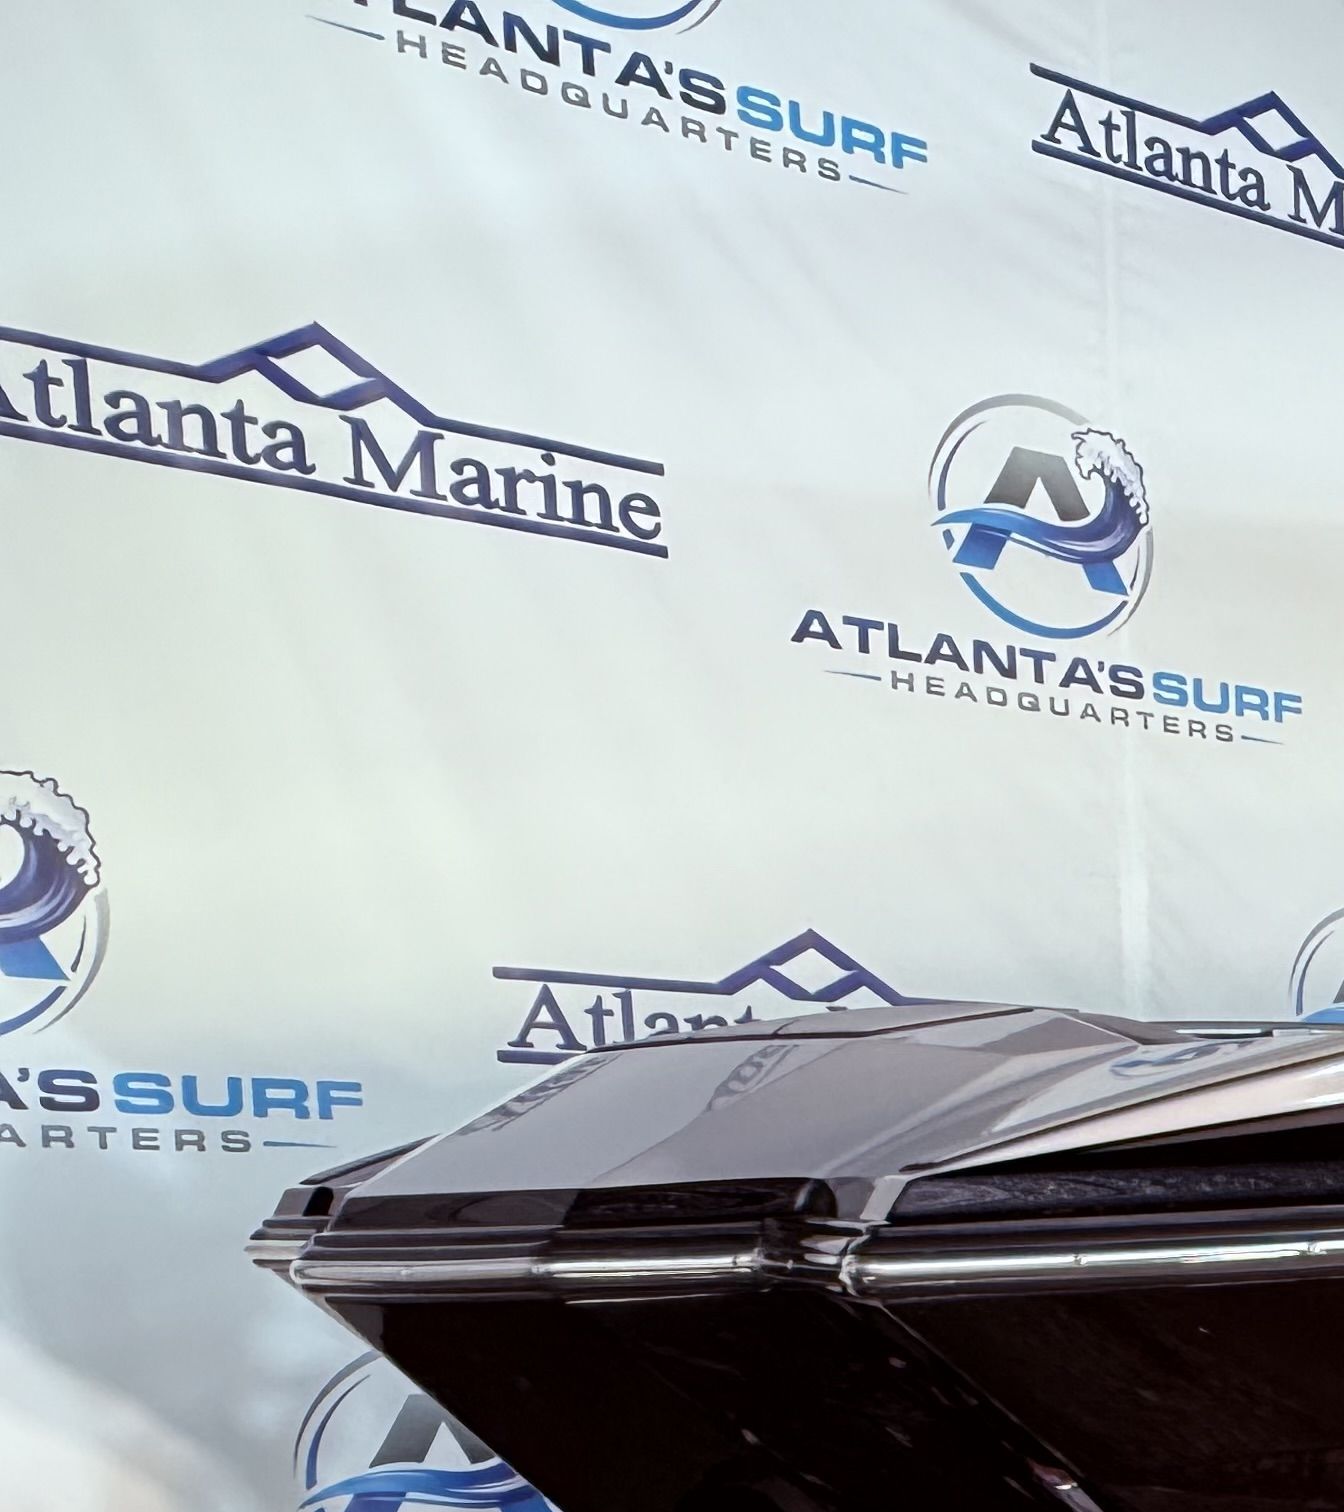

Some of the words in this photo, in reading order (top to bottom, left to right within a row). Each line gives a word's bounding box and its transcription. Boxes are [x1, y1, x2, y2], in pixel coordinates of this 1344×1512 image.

[397, 29, 841, 182] HEADQUARTERS
[1041, 89, 1270, 212] Atlanta
[340, 414, 662, 540] Marine
[890, 670, 1234, 743] HEADQUARTERS
[0, 1123, 252, 1152] ARTERS
